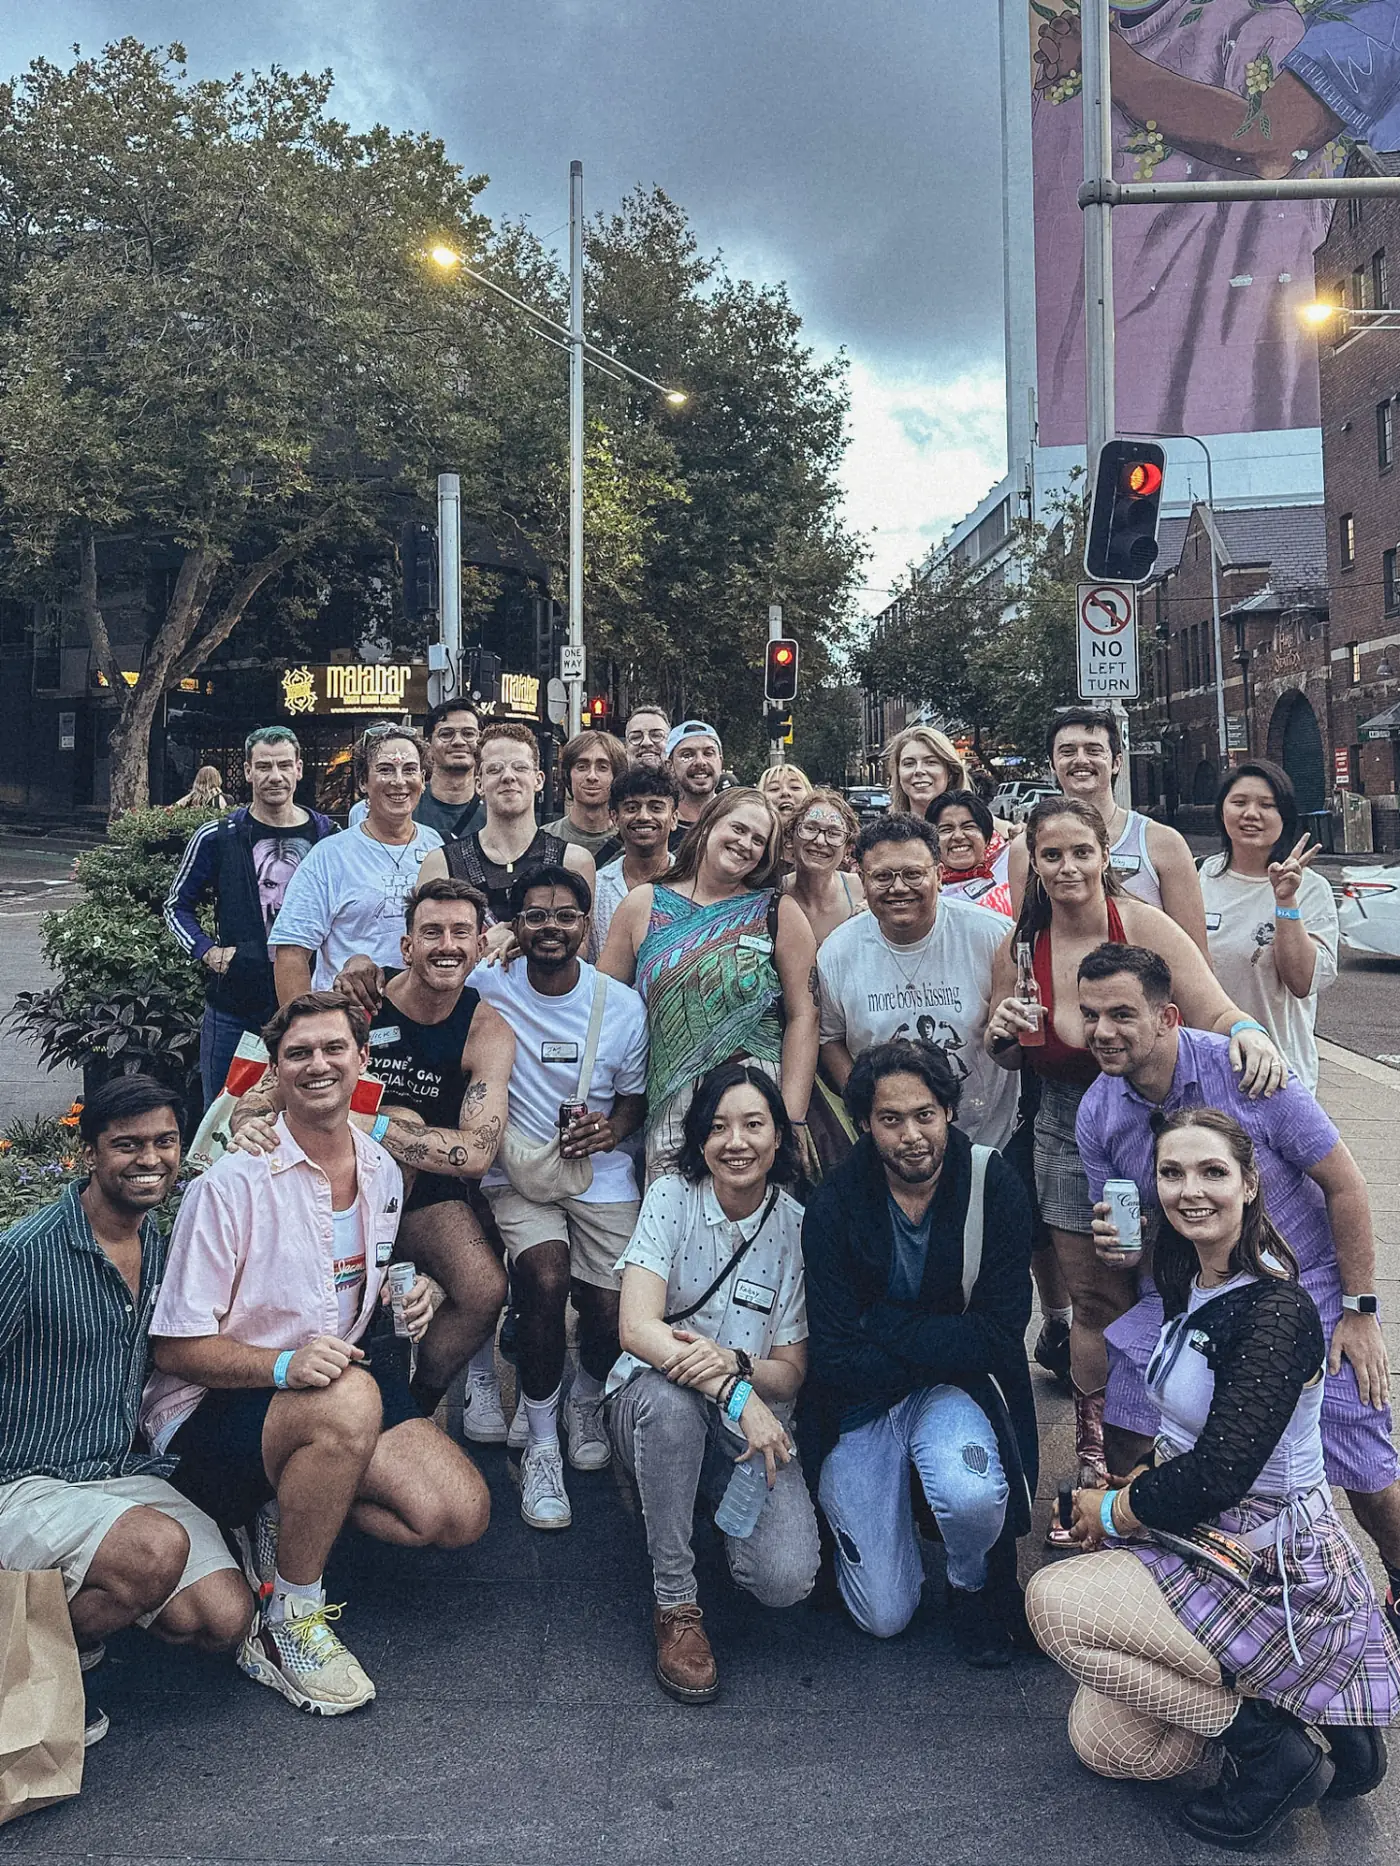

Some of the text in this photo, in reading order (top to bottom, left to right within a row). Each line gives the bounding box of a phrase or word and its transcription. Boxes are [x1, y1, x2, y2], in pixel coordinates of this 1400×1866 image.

[564, 648, 582, 657] ONE
[1092, 641, 1122, 657] NO
[563, 659, 583, 669] WAY
[1089, 662, 1127, 675] LEFT
[326, 664, 412, 699] malabar
[1088, 679, 1130, 691] TURN
[868, 981, 962, 1015] more boys kissing
[417, 1070, 442, 1084] GAY
[369, 1072, 405, 1086] OCIAL
[407, 1080, 440, 1098] CLUB
